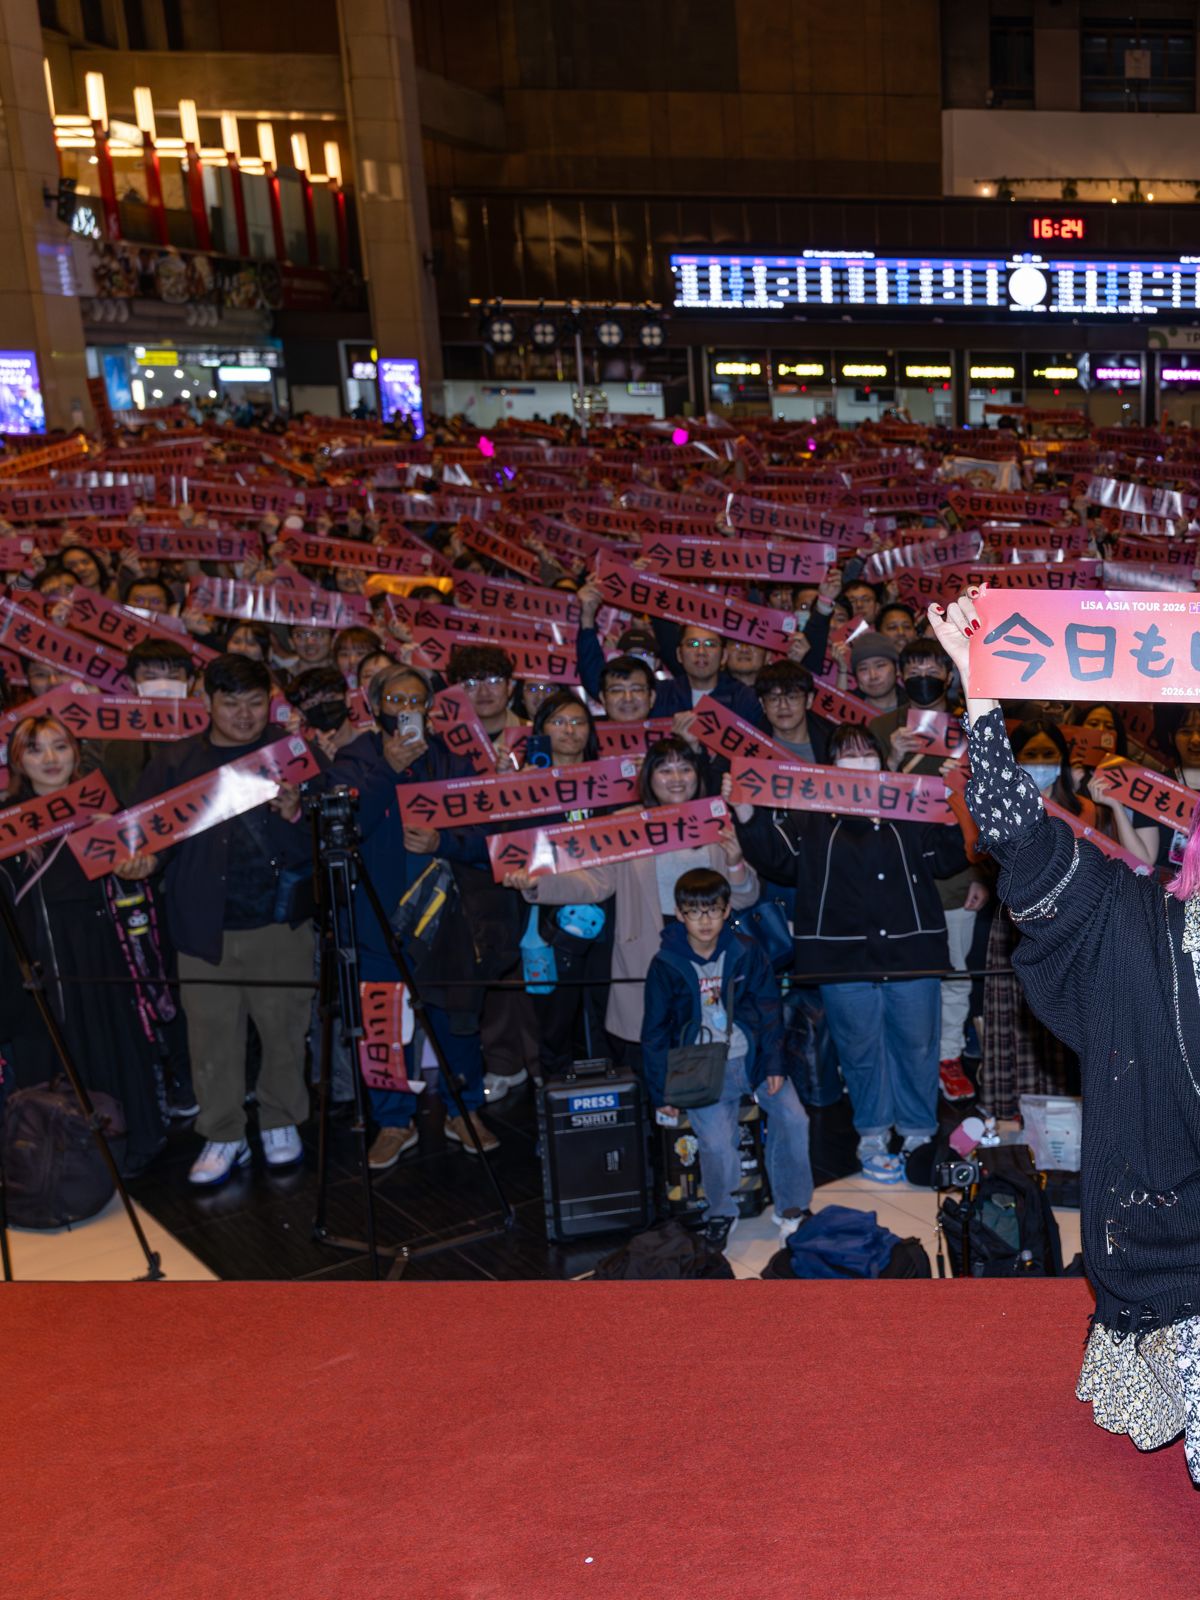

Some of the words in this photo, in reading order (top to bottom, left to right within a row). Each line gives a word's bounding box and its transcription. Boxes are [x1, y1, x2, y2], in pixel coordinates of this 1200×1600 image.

[1033, 219, 1083, 238] 16:24
[648, 543, 832, 576] 今日もいい日だっ
[602, 573, 789, 642] 今日もいい日だっ
[1106, 602, 1130, 611] ASIA
[1132, 602, 1161, 612] TOUR
[1163, 603, 1186, 612] 2026
[407, 773, 634, 822] 今日もいい日だっ
[736, 767, 952, 814] 今日もいい日だっ
[498, 815, 726, 870] 今もいい日だっ
[573, 1094, 615, 1110] PRESS
